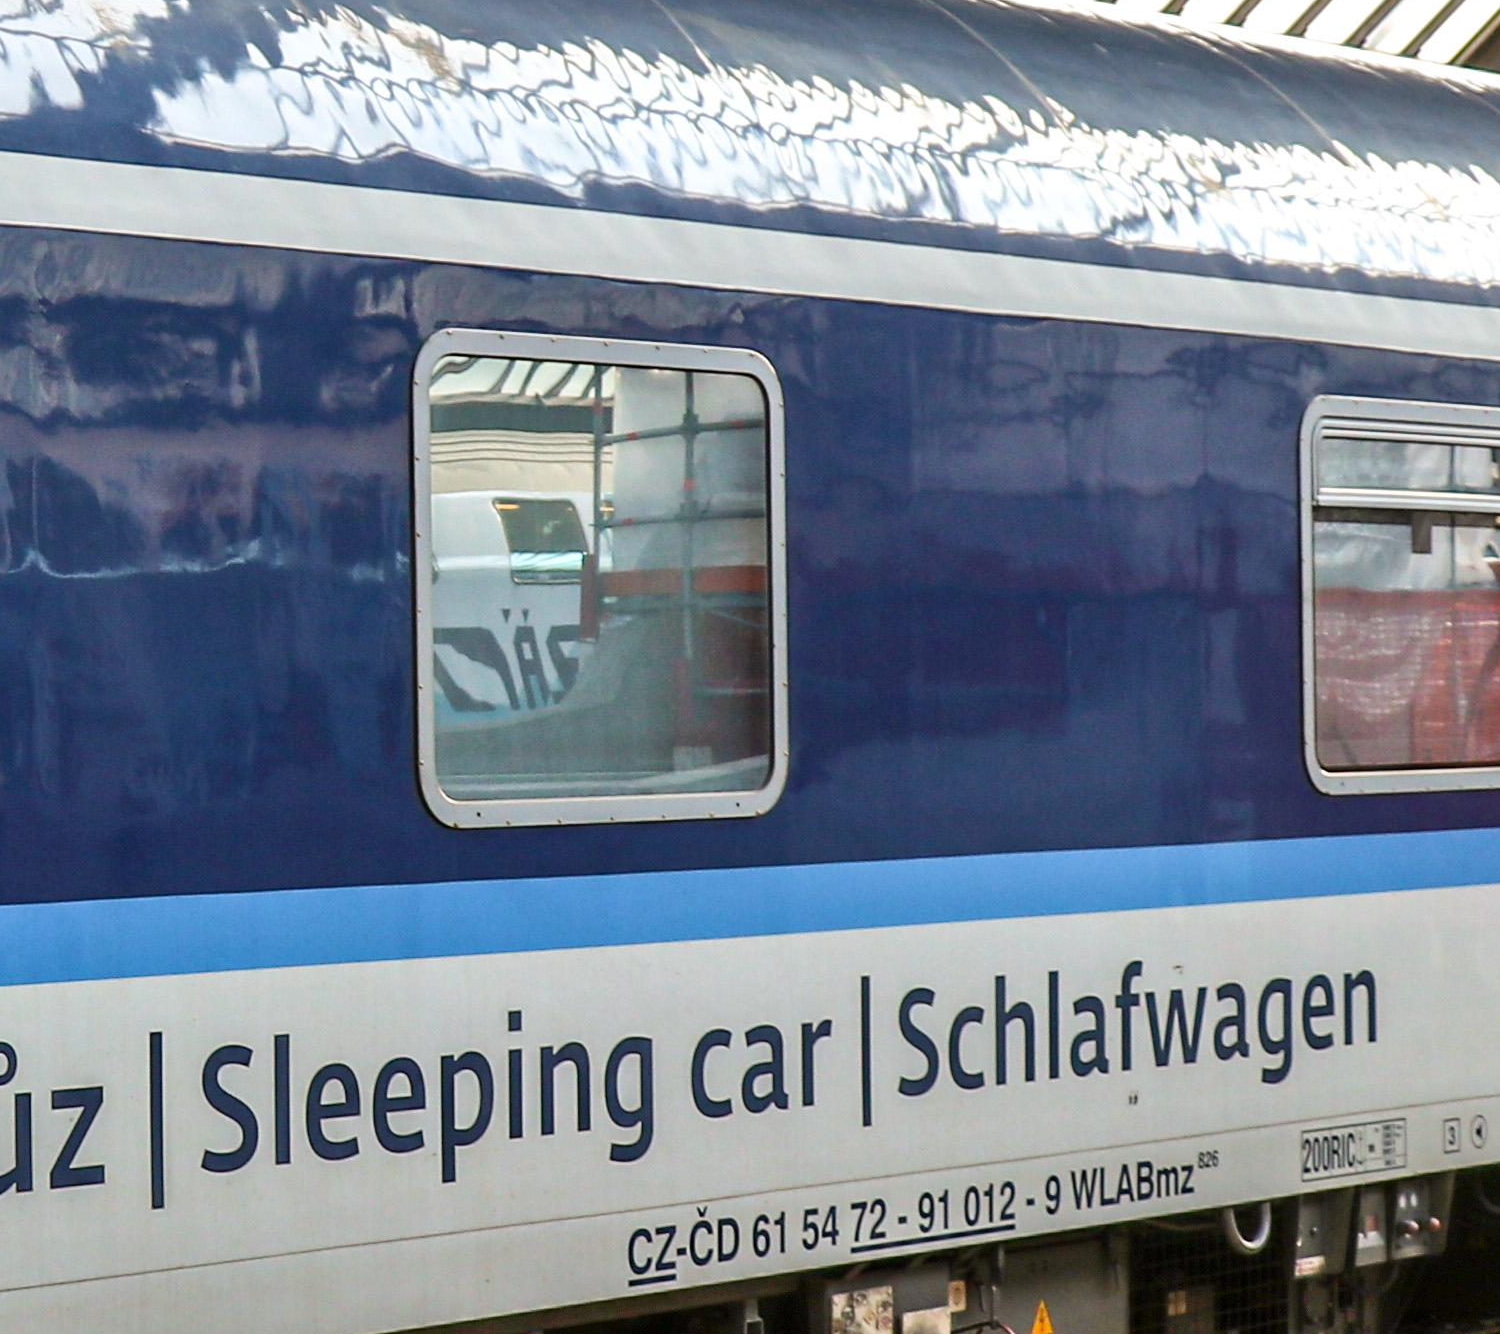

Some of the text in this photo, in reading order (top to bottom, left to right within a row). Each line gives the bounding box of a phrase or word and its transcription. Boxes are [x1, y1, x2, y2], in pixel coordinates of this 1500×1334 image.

[200, 1010, 654, 1184] Sleeping
[691, 1018, 832, 1118] car
[898, 960, 1379, 1098] Schlafwagen
[1449, 1124, 1457, 1146] 3
[627, 1206, 741, 1277] CZ-ČD
[751, 1211, 788, 1259] 61
[801, 1205, 840, 1252] 54
[850, 1198, 888, 1243] 72
[918, 1188, 952, 1234] 91
[964, 1180, 1016, 1227] 012
[1045, 1174, 1061, 1215] 9
[1070, 1160, 1196, 1210] WLABmz
[1197, 1150, 1220, 1169] 826
